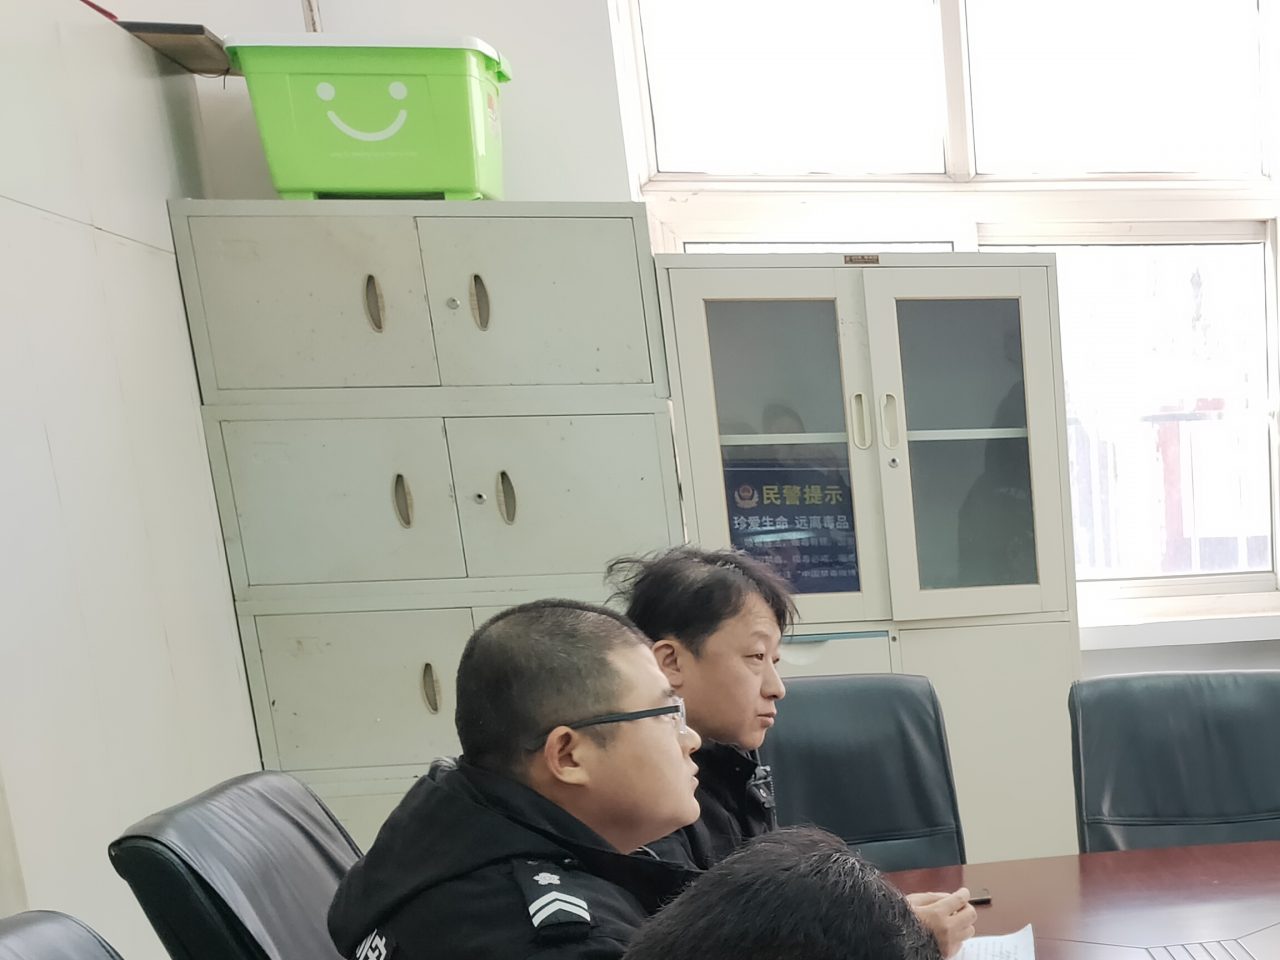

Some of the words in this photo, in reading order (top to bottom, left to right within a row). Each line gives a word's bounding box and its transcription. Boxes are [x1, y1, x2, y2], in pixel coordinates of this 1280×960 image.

[762, 485, 843, 505] 民警提示
[733, 515, 788, 530] 珍爱生命
[795, 515, 849, 530] 远离毒品
